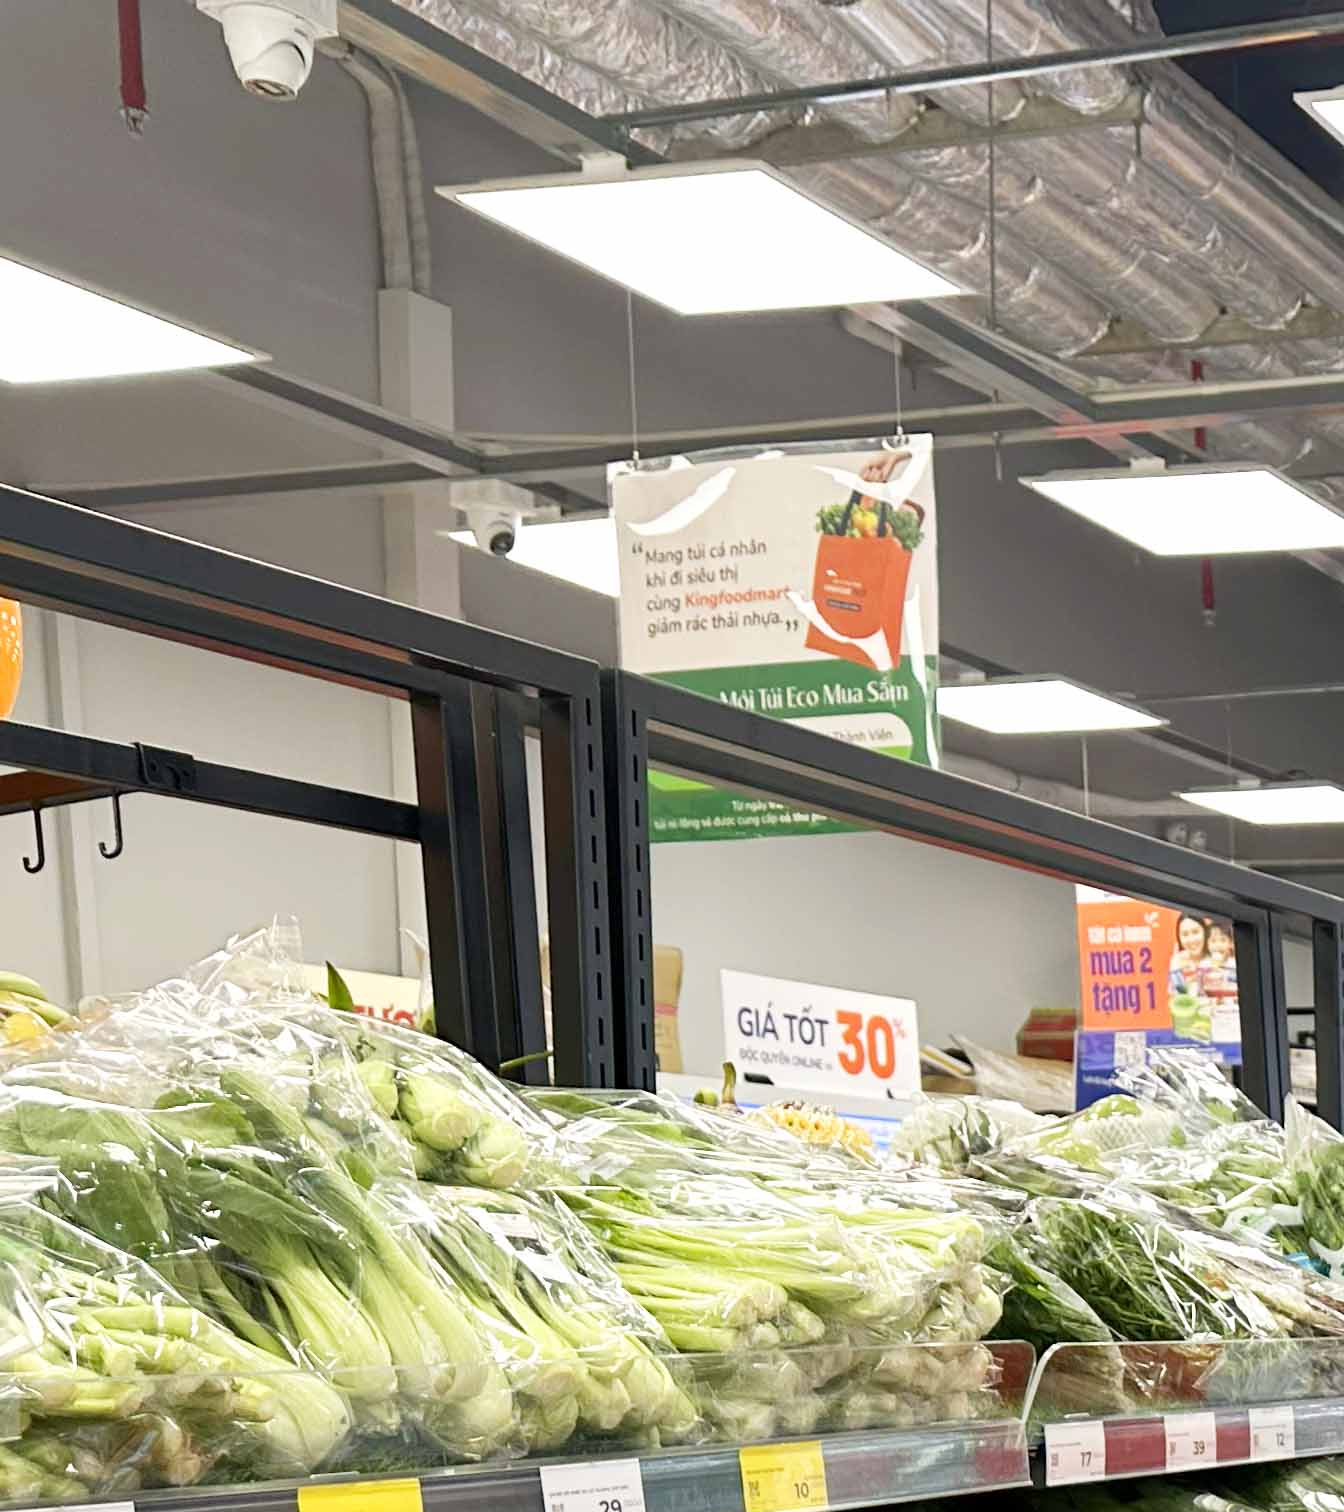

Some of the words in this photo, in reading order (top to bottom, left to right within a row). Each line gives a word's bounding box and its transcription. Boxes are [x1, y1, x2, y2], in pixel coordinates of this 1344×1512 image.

[687, 544, 706, 562] túi
[709, 542, 727, 559] cá
[729, 539, 767, 558] nhân
[645, 569, 668, 588] khi
[670, 567, 684, 585] đi
[687, 566, 717, 584] siêu
[719, 564, 739, 584] thị
[646, 592, 682, 612] cùng
[684, 582, 792, 609] Kingfoodmart
[647, 614, 683, 637] giảm
[687, 613, 709, 632] rác
[712, 609, 749, 630] thải
[758, 686, 786, 710] Túi
[788, 684, 820, 707] Eco
[824, 682, 865, 706] Mua
[867, 676, 910, 705] Sắm
[1090, 949, 1134, 976] mua
[1139, 948, 1153, 974] 2
[1092, 982, 1141, 1015] tặng
[1147, 982, 1157, 1010] 1
[737, 1002, 779, 1041] GIÁ
[783, 1004, 829, 1047] TỐT
[1081, 1452, 1093, 1467] 17
[1193, 1441, 1205, 1456] 39
[794, 1482, 809, 1498] 10
